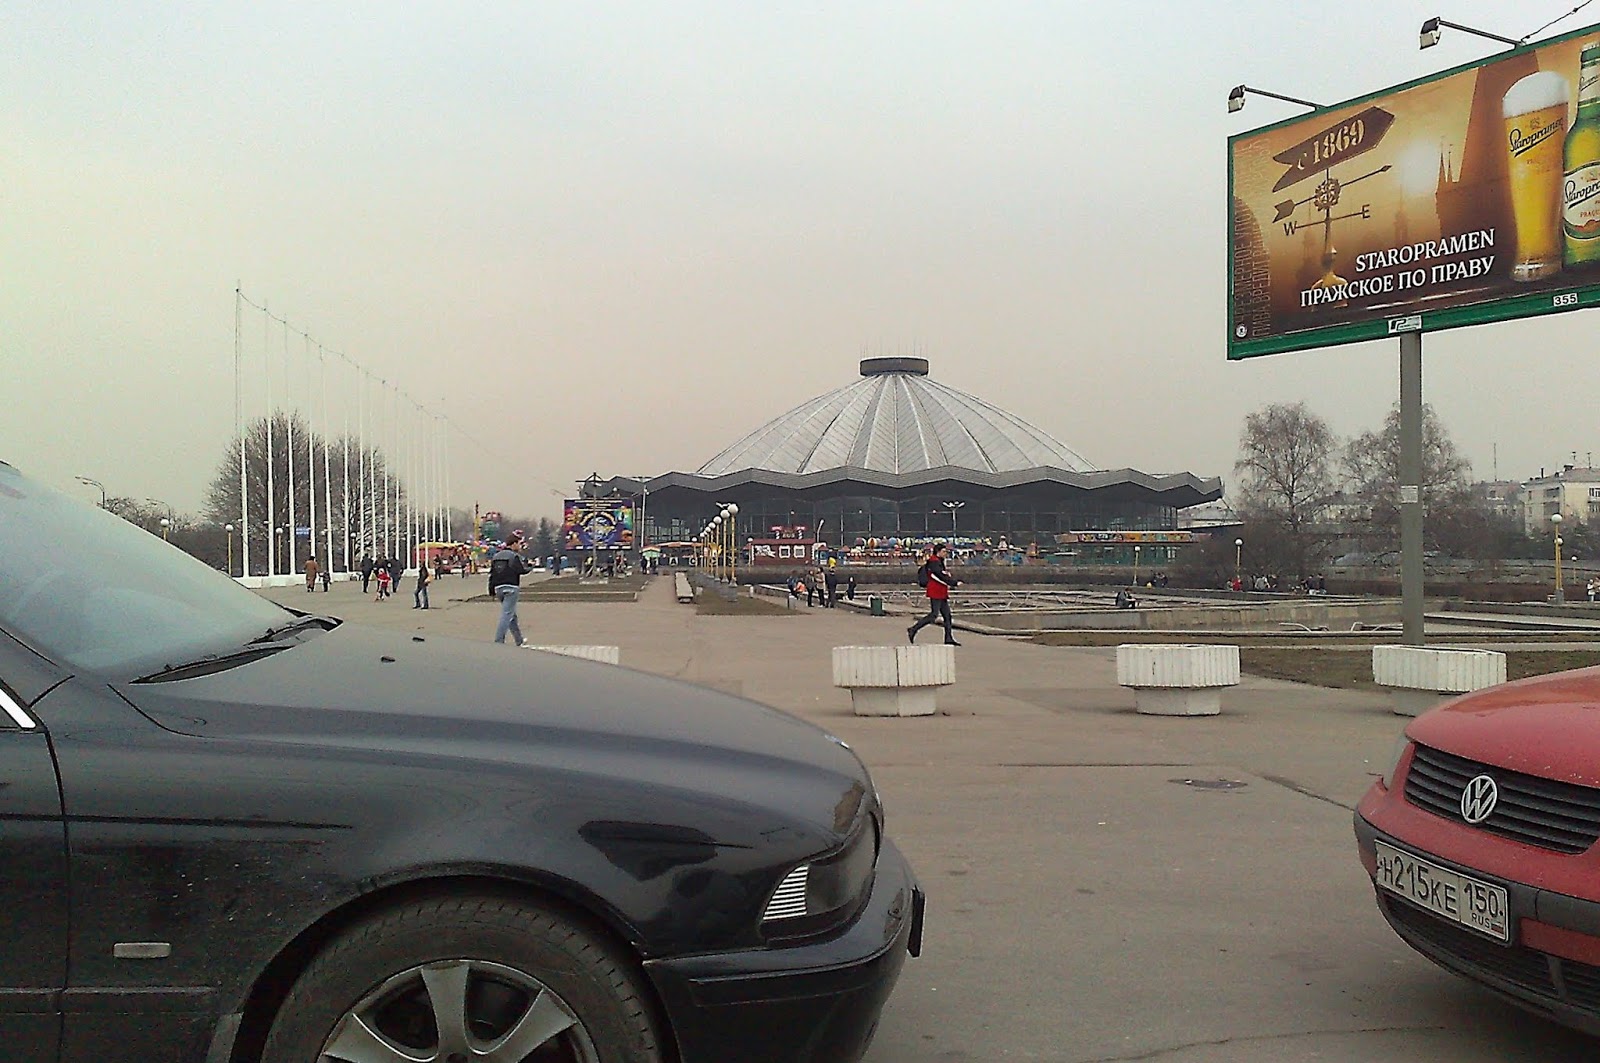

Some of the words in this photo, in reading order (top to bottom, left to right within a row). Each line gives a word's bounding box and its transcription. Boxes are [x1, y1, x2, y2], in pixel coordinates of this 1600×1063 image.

[1313, 119, 1365, 164] 1869
[1510, 118, 1563, 152] Staropramen
[1283, 221, 1297, 236] W
[1362, 204, 1370, 219] E
[1355, 228, 1495, 272] STAROPRAMEN
[1301, 275, 1394, 306] ПРАЖСКОЕ
[1398, 269, 1426, 290] ПО
[1431, 255, 1495, 284] ПРАВУ
[1554, 294, 1577, 305] 355
[1464, 882, 1498, 917] 150
[1471, 913, 1491, 929] RUS
